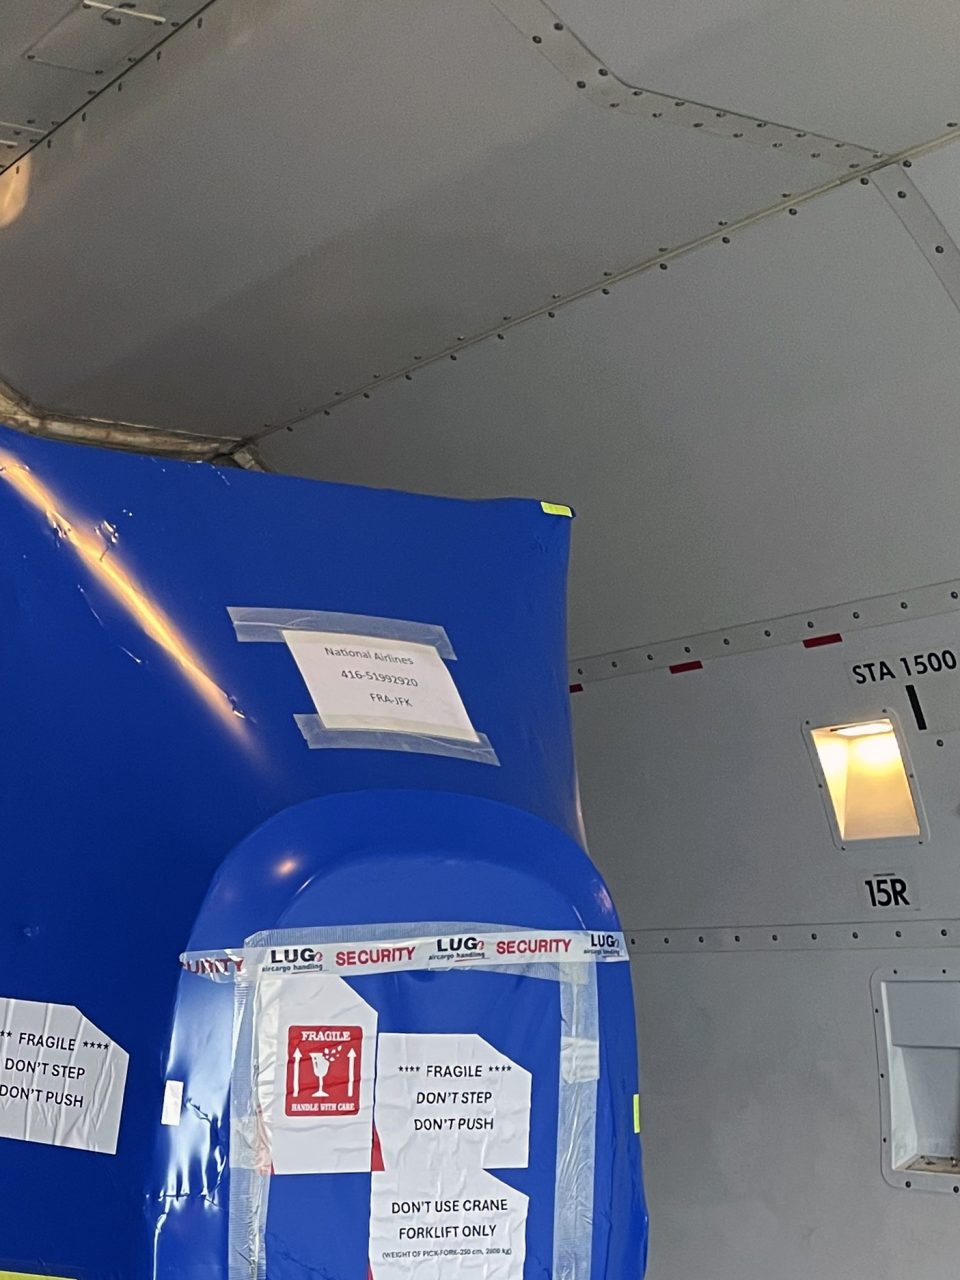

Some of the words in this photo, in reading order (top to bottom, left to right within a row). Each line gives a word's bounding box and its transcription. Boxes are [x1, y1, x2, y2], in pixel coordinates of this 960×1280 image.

[324, 647, 372, 659] National
[374, 652, 414, 665] Airlines
[852, 661, 896, 684] STA
[900, 649, 957, 676] 1500
[341, 670, 418, 687] 416-51992920
[369, 693, 413, 707] FRA-JFK
[865, 879, 910, 906] 15R
[437, 937, 477, 952] LUG
[496, 939, 572, 955] SECURITY
[271, 948, 315, 963] LUG
[335, 946, 416, 967] SECURITY
[262, 963, 291, 972] aircargo
[293, 963, 323, 971] handling
[19, 1032, 76, 1051] FRAGILE
[301, 1031, 350, 1041] FRAGILE
[5, 1058, 49, 1075] DON'T
[52, 1064, 85, 1080] STEP
[426, 1065, 482, 1078] FRAGILE
[0, 1084, 43, 1102] DON'T
[46, 1091, 84, 1108] PUSH
[416, 1092, 459, 1104] DON'T
[461, 1091, 492, 1104] STEP
[291, 1103, 319, 1111] HANDLE
[320, 1103, 336, 1111] WITH
[338, 1103, 355, 1111] CARE
[414, 1118, 455, 1130] DON'T
[458, 1118, 494, 1130] PUSH
[392, 1201, 431, 1214] DON'T
[435, 1200, 460, 1212] USE
[462, 1199, 508, 1212] CRANE
[399, 1226, 459, 1240] FORKLIFT
[462, 1225, 497, 1238] ONLY
